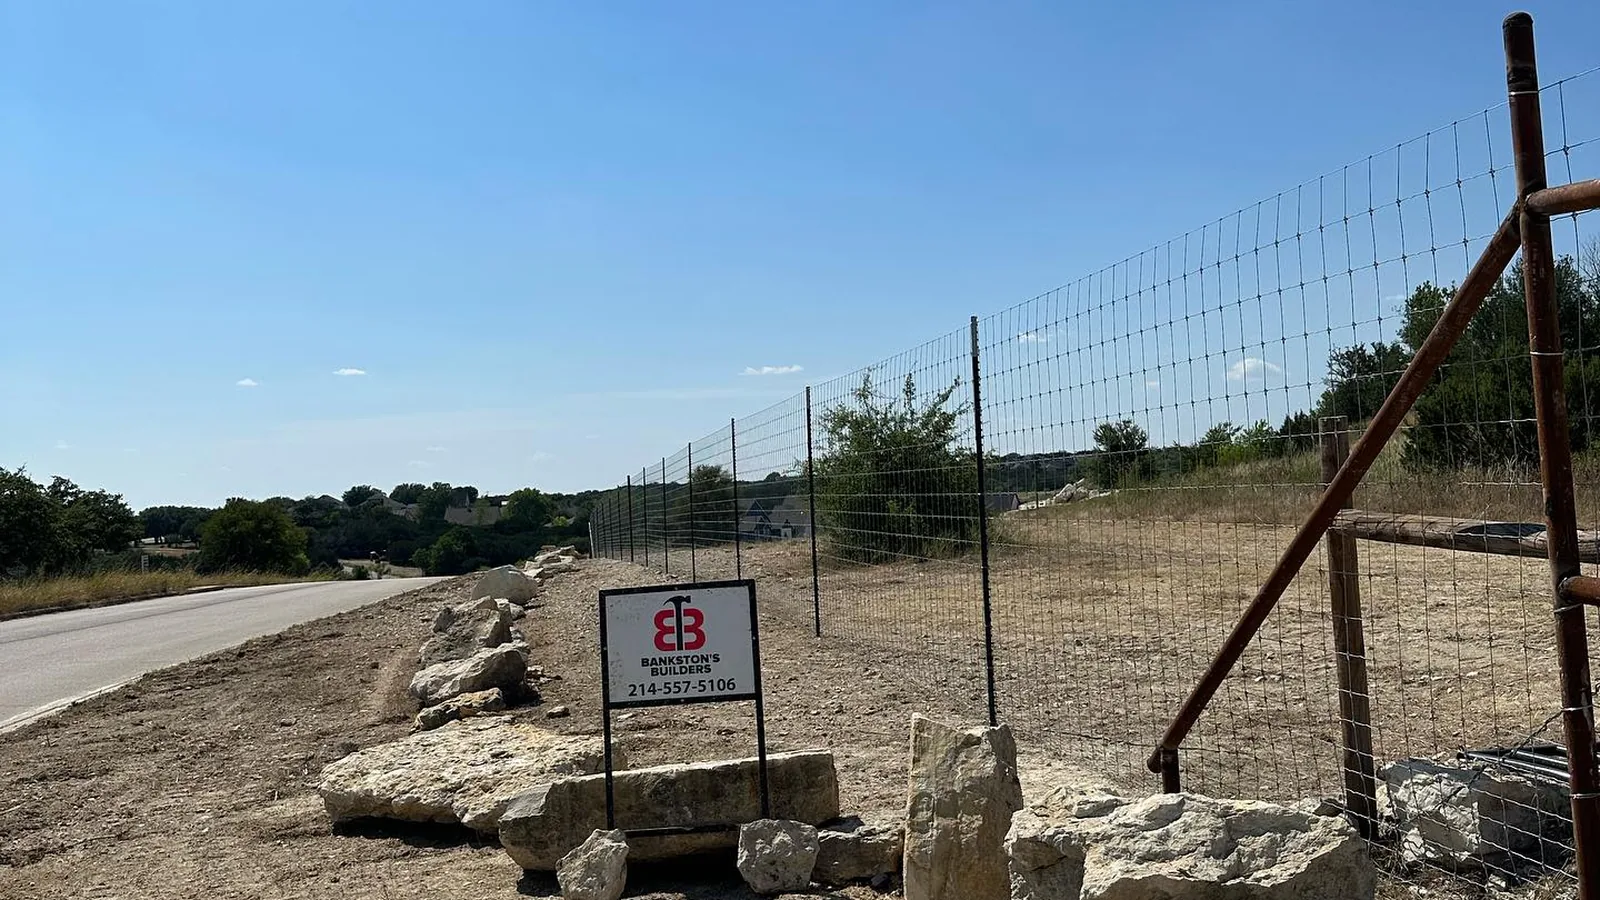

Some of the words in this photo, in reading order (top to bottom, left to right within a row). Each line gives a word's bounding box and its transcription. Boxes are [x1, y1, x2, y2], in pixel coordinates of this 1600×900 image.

[641, 654, 720, 667] BANKSTON'S
[650, 664, 711, 676] BUILDERS
[628, 678, 736, 696] 214-557-5106
